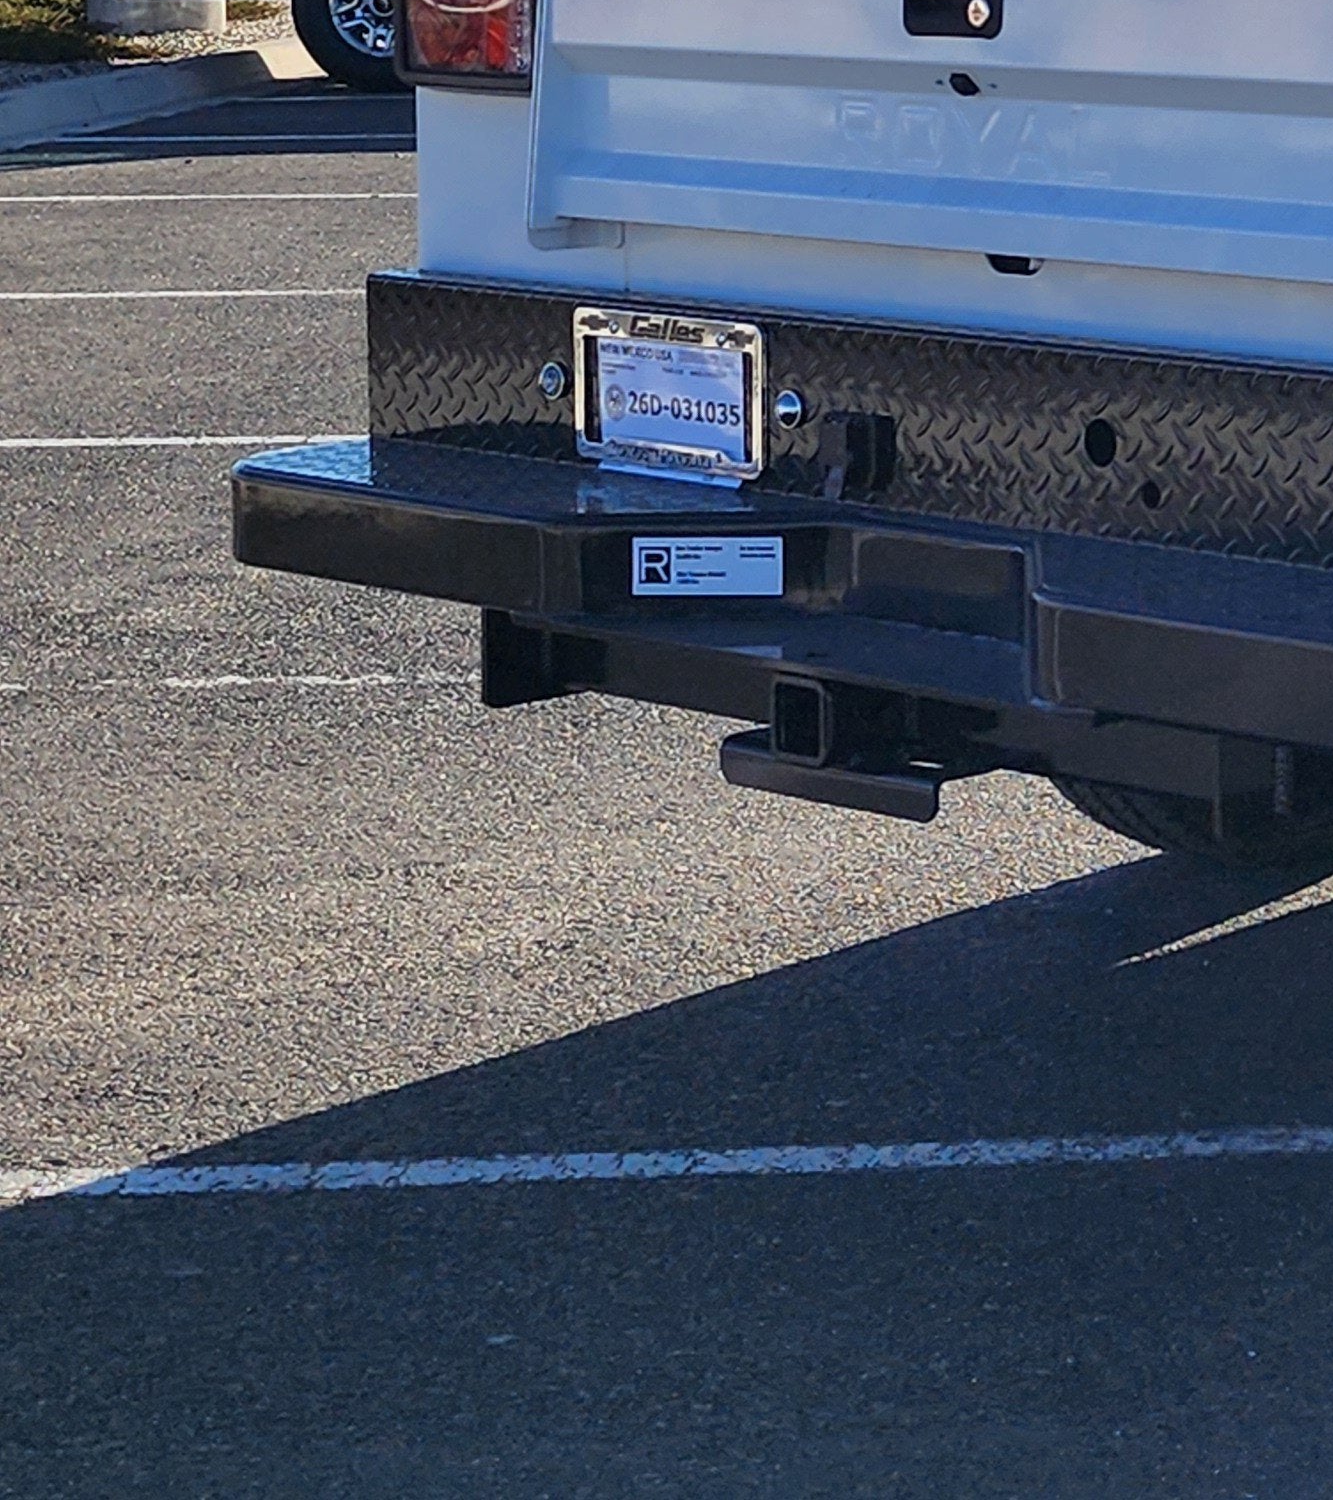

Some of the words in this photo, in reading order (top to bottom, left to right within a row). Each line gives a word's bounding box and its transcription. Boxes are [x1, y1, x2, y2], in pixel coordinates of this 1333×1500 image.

[629, 315, 705, 344] Galles
[628, 390, 741, 427] 26D-031035
[640, 549, 669, 582] R
